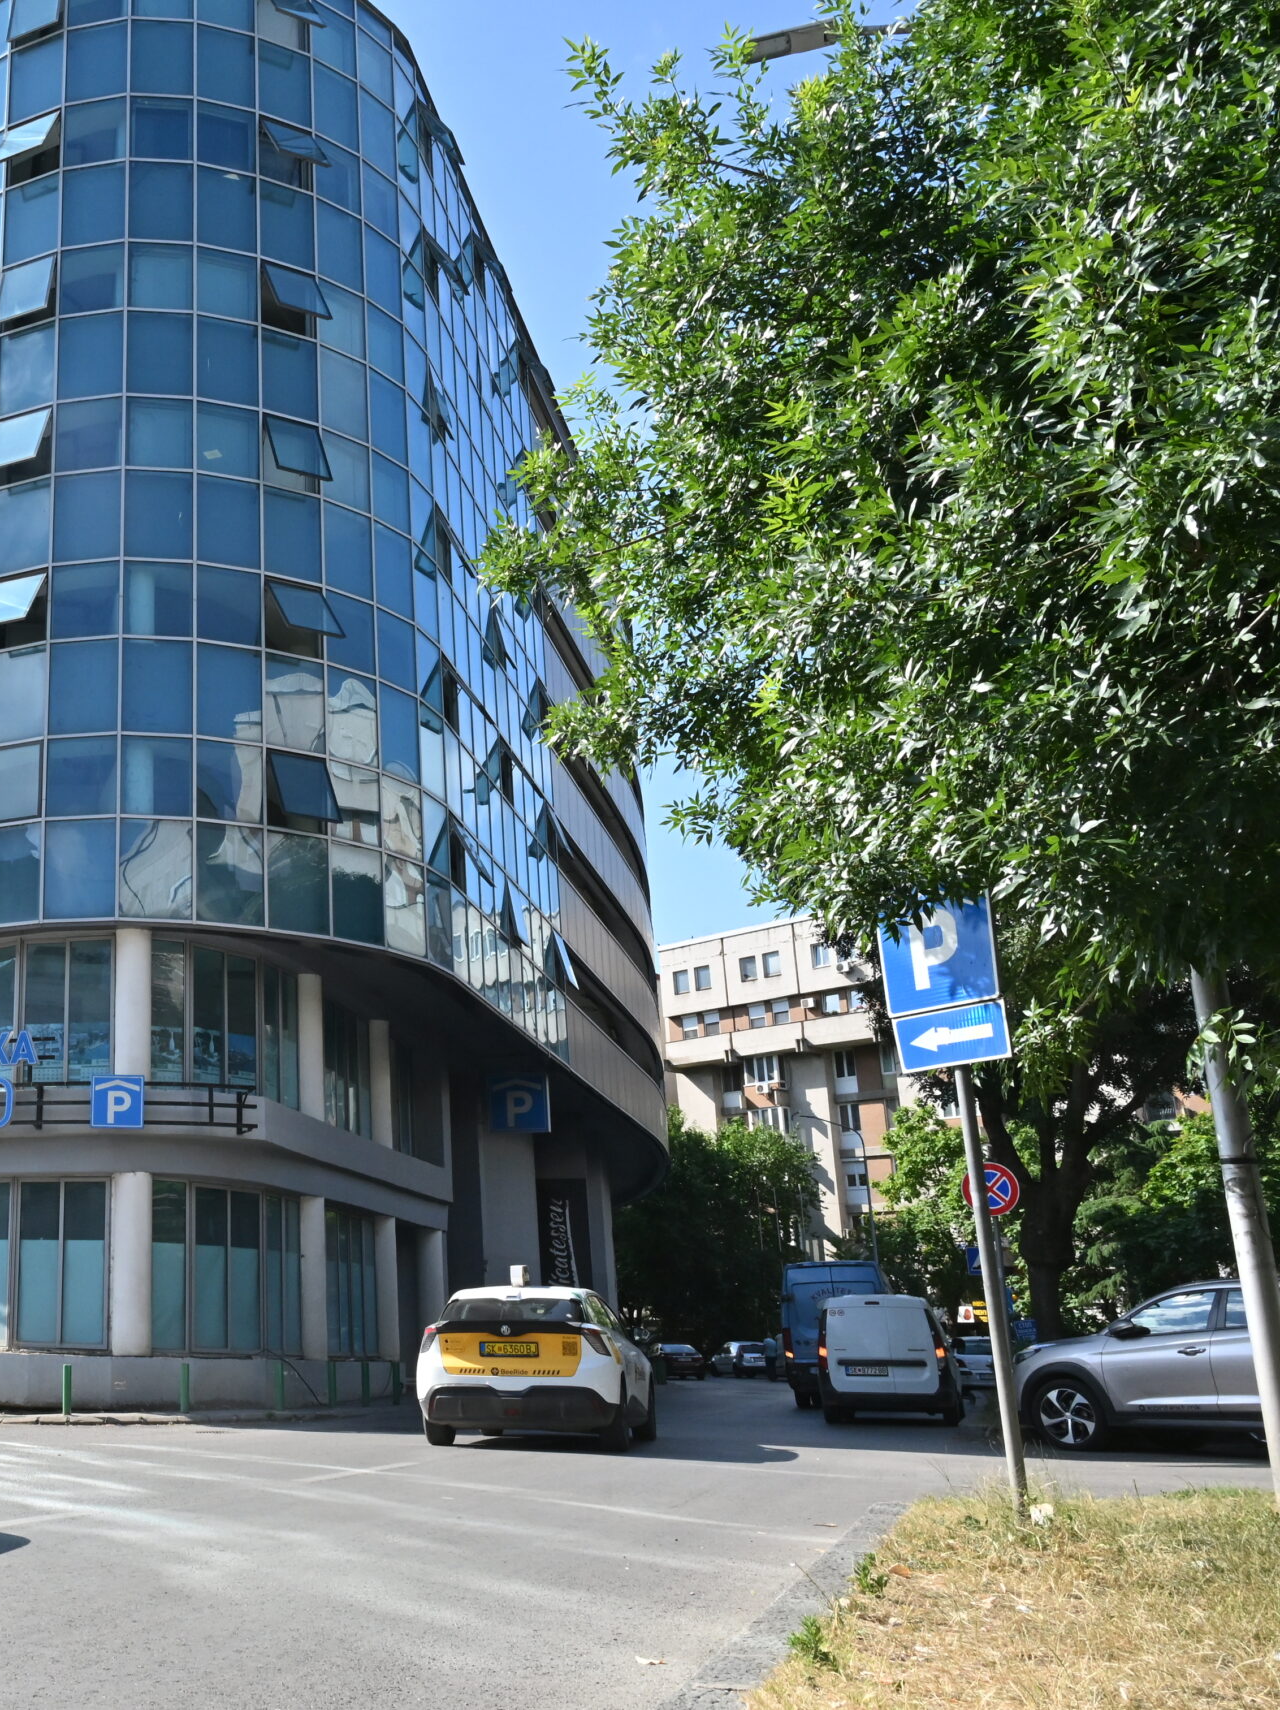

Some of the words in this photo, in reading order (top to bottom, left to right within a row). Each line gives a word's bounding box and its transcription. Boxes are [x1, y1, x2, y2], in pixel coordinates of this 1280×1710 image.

[909, 908, 958, 991] P
[107, 1090, 132, 1124] P
[506, 1091, 533, 1128] P
[486, 1343, 496, 1353] SK
